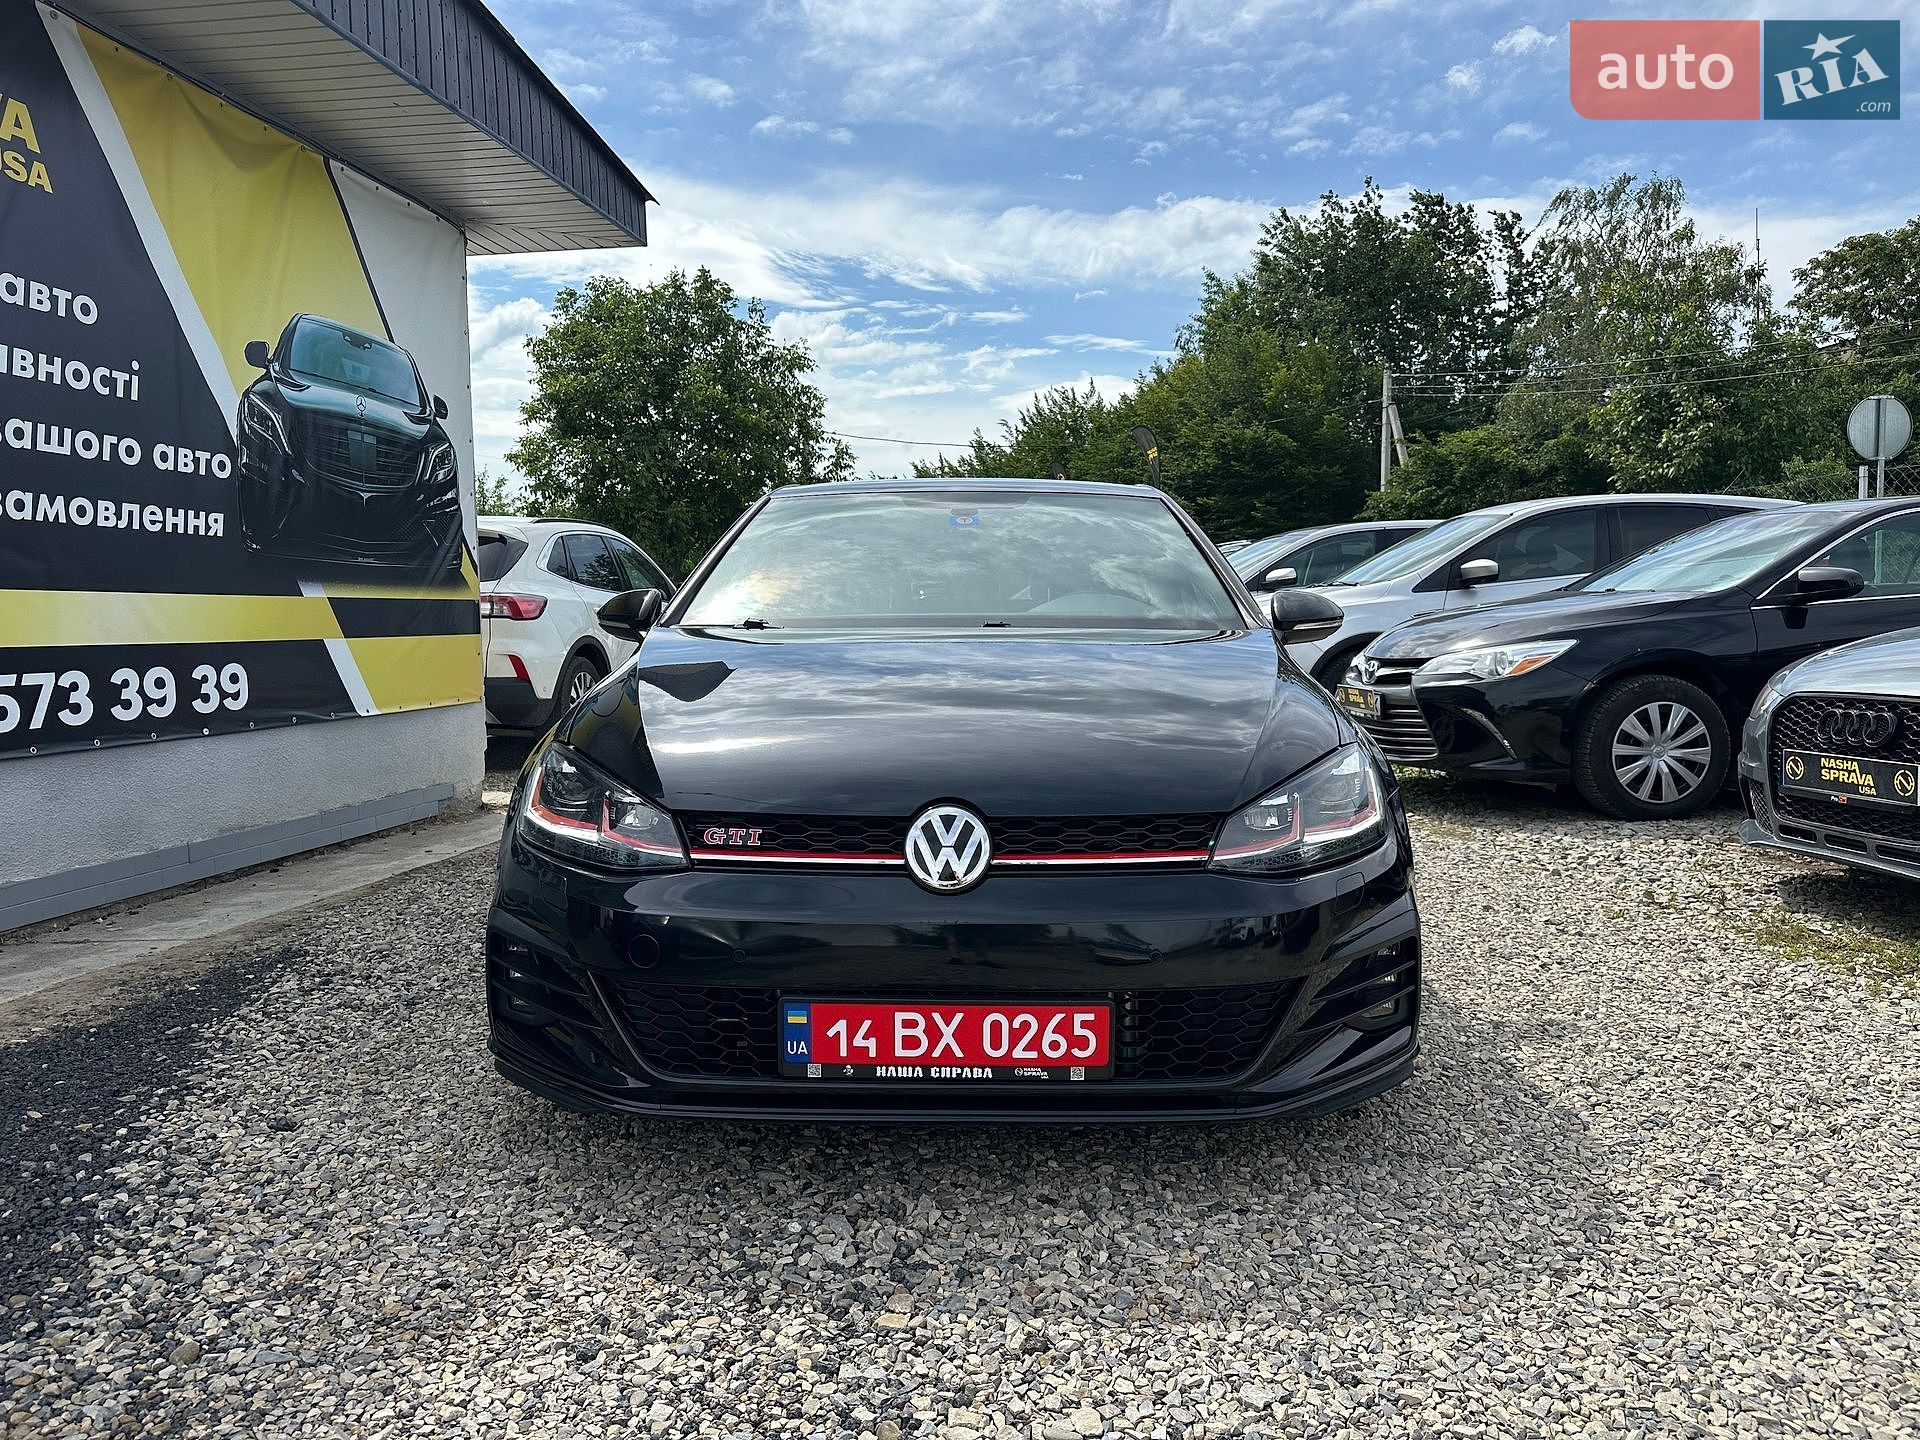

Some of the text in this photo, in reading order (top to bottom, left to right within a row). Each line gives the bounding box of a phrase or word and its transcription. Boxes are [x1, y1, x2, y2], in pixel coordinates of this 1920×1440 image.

[0, 93, 41, 154] A
[0, 148, 53, 194] SA
[0, 272, 98, 325] авто
[0, 418, 232, 479] ашого авто
[0, 489, 225, 537] амовлення
[110, 666, 177, 721] 39
[191, 662, 249, 714] 39
[1820, 757, 1859, 770] NASHA
[1821, 768, 1874, 786] SPRAVA
[1858, 786, 1877, 796] USA
[703, 827, 762, 846] GTI
[787, 1041, 808, 1055] UA
[826, 1012, 1098, 1059] 14 BX 0265
[876, 1066, 993, 1079] НАША СПРАВА
